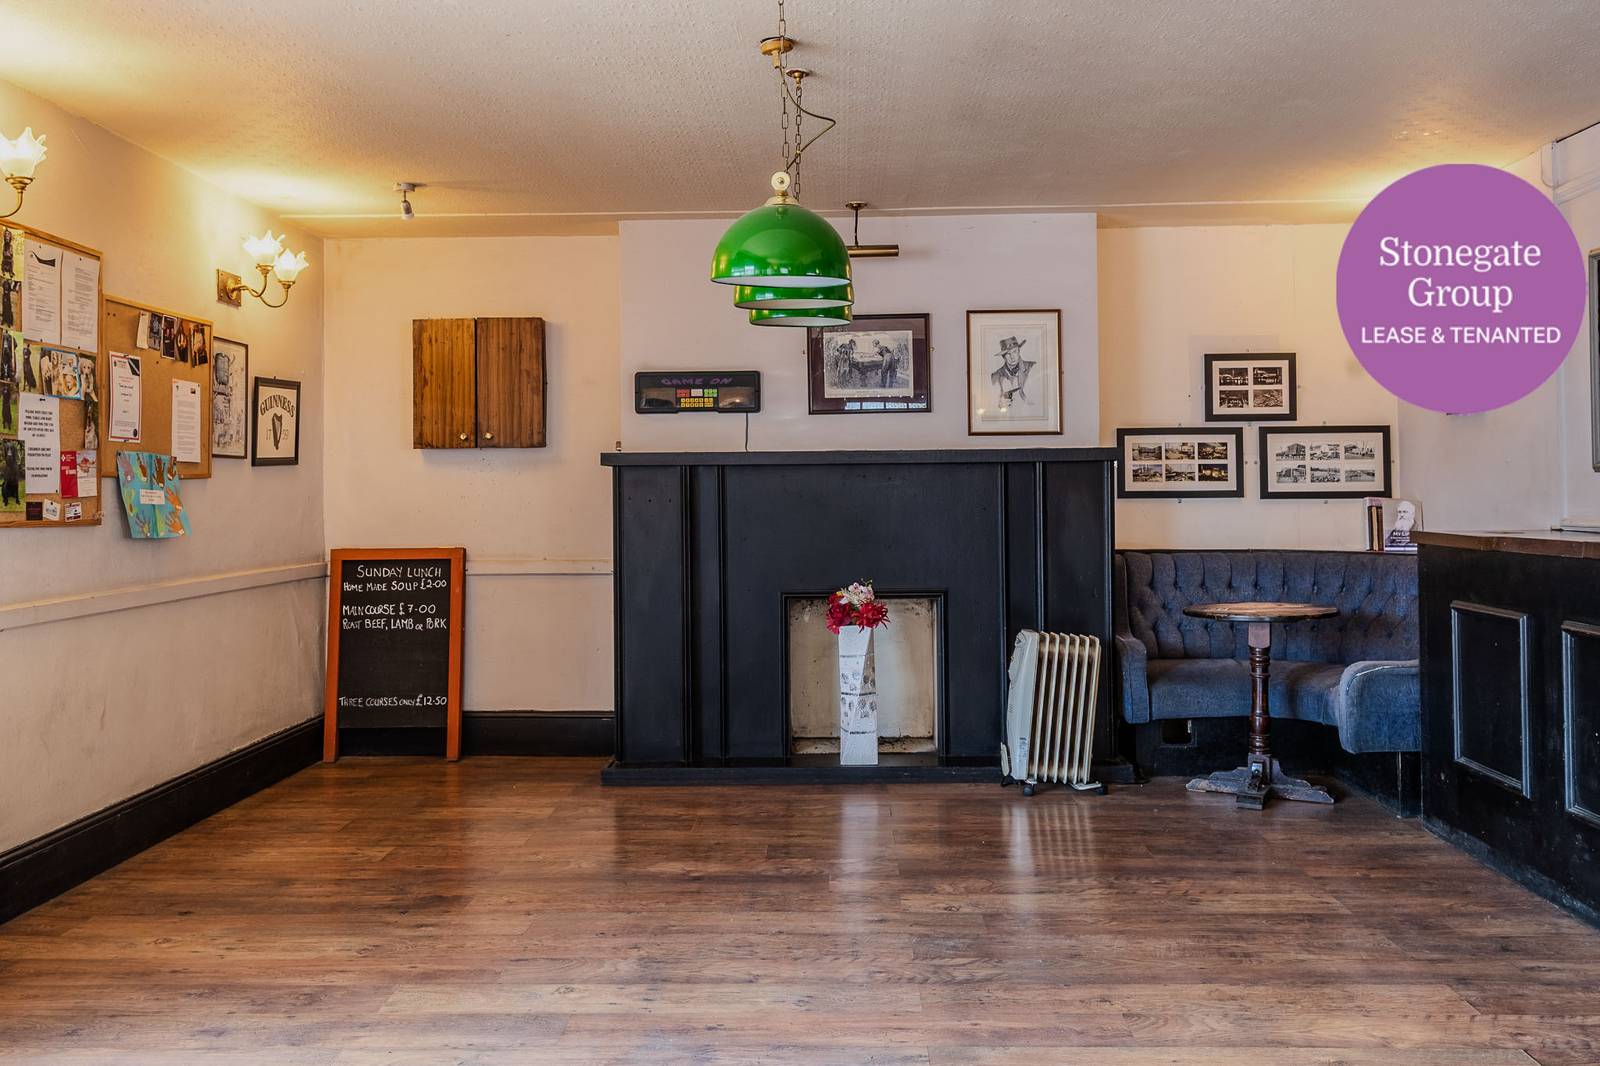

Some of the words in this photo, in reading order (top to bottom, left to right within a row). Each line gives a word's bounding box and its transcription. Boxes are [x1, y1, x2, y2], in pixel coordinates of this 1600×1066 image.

[660, 378, 703, 386] GAME
[710, 377, 734, 385] ON
[260, 394, 296, 418] GUINNESS
[357, 564, 403, 578] SUNDAY
[407, 566, 442, 578] LUNCH
[343, 582, 364, 592] HOME
[366, 582, 388, 592] MADE
[390, 580, 419, 591] SOUP
[342, 604, 364, 616] MAIN
[364, 604, 396, 616] COURSE
[342, 618, 363, 630] ROAST
[364, 618, 389, 631] BEEF,
[390, 618, 414, 630] LAMB
[426, 617, 448, 630] PORK
[338, 696, 364, 708] THREE
[366, 696, 398, 707] COURSES
